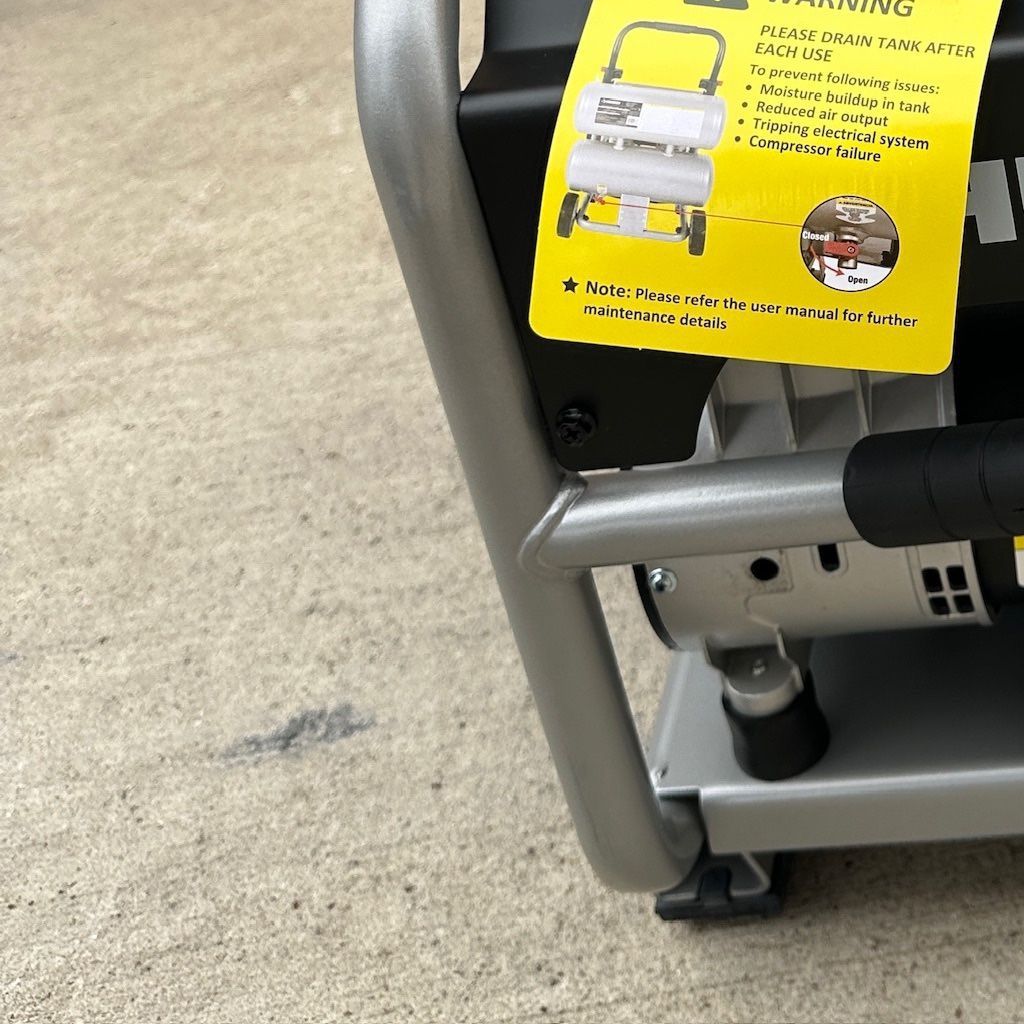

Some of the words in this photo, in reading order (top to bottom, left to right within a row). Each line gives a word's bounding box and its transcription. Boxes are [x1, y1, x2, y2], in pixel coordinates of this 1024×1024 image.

[755, 42, 798, 58] EACH
[802, 47, 833, 62] USE
[760, 25, 818, 41] PLEASE
[821, 31, 873, 47] DRAIN
[878, 37, 922, 52] TANK
[924, 42, 976, 58] AFTER
[750, 64, 765, 76] To
[769, 68, 823, 82] prevent
[826, 72, 890, 91] following
[894, 79, 940, 94] issues:
[759, 84, 822, 102] Moisture
[825, 90, 878, 110] buildup
[882, 97, 895, 110] in
[899, 101, 931, 114] tank
[756, 101, 816, 118] Reduced
[819, 108, 838, 120] air
[841, 113, 888, 127] output
[753, 118, 810, 138] Tripping
[813, 125, 876, 144] electrical
[880, 134, 929, 150] system
[749, 135, 832, 156] Compressor
[836, 145, 881, 162] failure
[802, 230, 830, 241] Closed
[847, 275, 868, 284] Open
[586, 280, 631, 298] Note:
[635, 288, 680, 304] Please
[685, 294, 719, 308] refer
[723, 297, 747, 311] the
[751, 302, 782, 314] user
[785, 306, 839, 321] manual
[842, 309, 864, 323] for
[867, 311, 918, 327] further
[584, 305, 675, 324] maintenance
[680, 313, 727, 330] details
